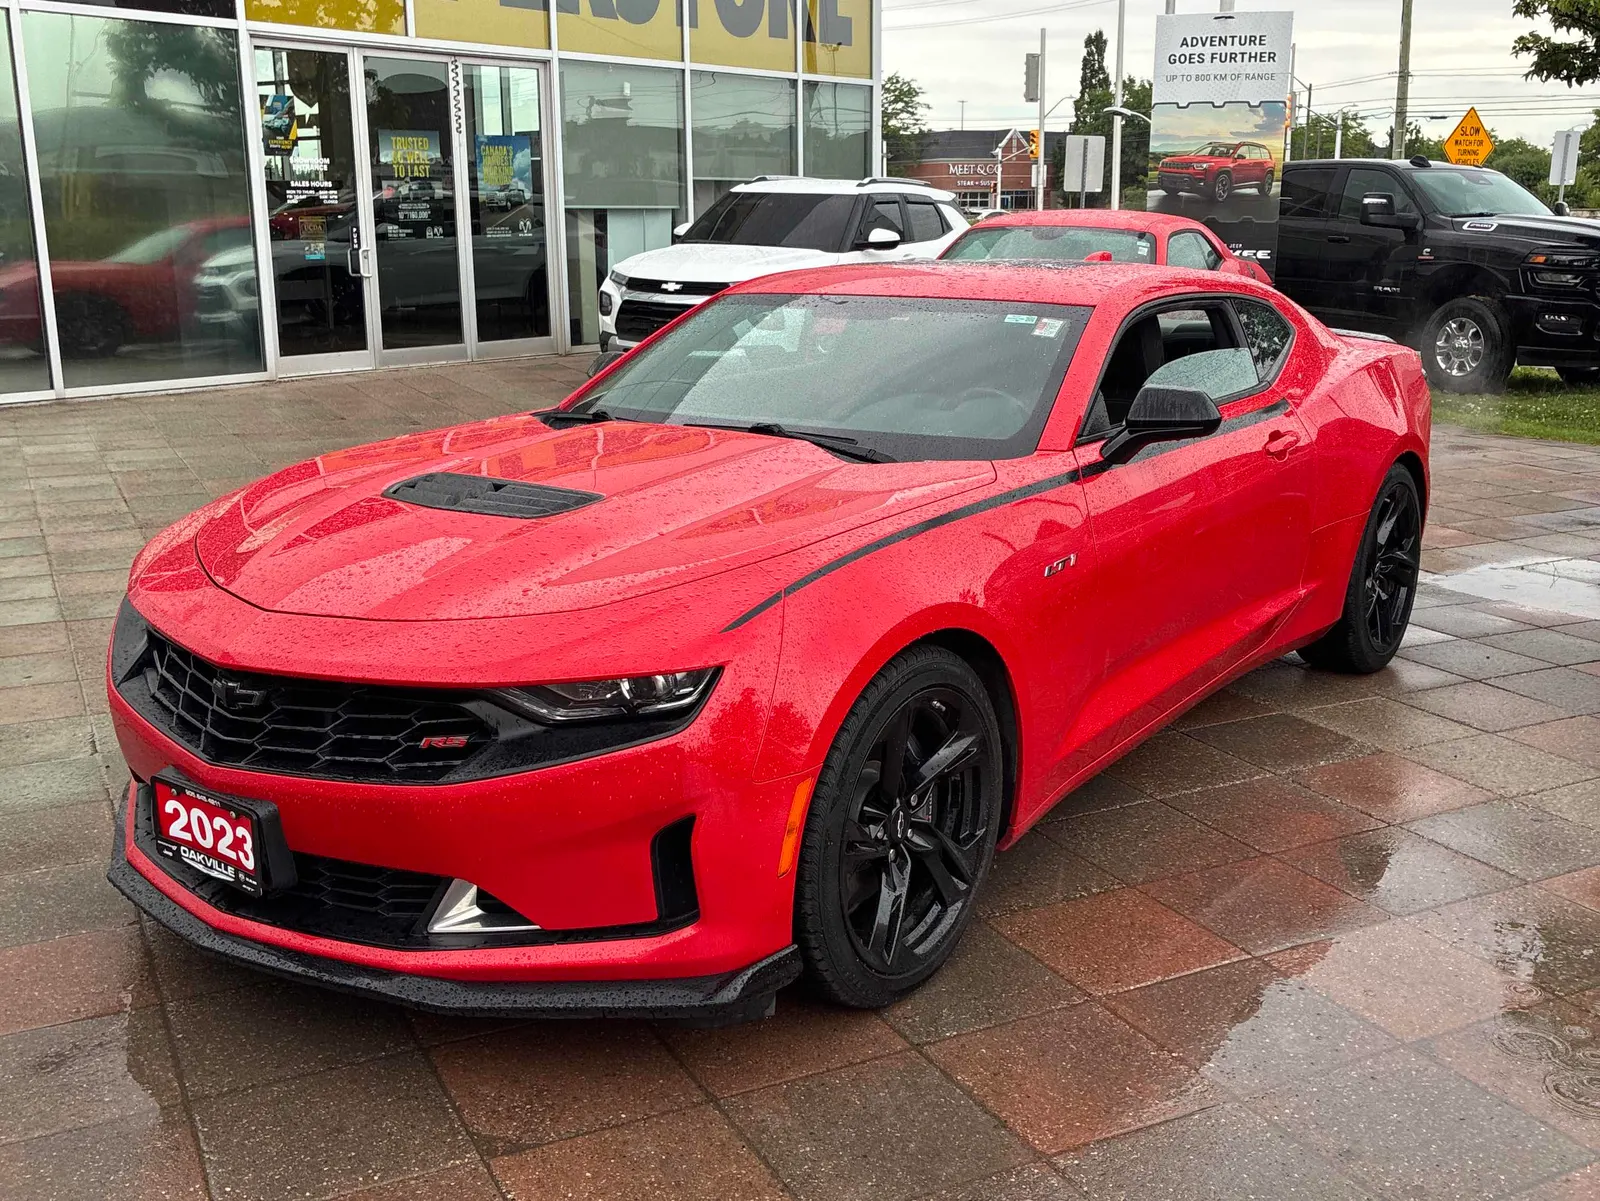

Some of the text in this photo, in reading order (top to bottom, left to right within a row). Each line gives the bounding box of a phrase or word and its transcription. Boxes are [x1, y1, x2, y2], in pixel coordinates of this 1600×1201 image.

[1179, 34, 1267, 48] ADVENTURE
[1167, 51, 1277, 65] GOES FURTHER
[1180, 74, 1192, 82] TO
[1194, 74, 1211, 82] 800
[1213, 73, 1228, 82] KM
[1230, 73, 1242, 81] OF
[1244, 73, 1276, 81] RANGE
[1460, 126, 1481, 137] SLOW
[391, 136, 429, 151] TRUSTED
[480, 144, 514, 156] CANADA'S
[1454, 139, 1484, 147] WATCH FOR
[407, 151, 430, 165] WELL
[1457, 148, 1479, 157] TURNING
[393, 164, 430, 178] TO LAST
[948, 163, 975, 176] MEET
[976, 164, 988, 176] &
[419, 735, 470, 749] RS
[164, 799, 255, 871] 2023
[180, 846, 236, 878] OAKVILLE
